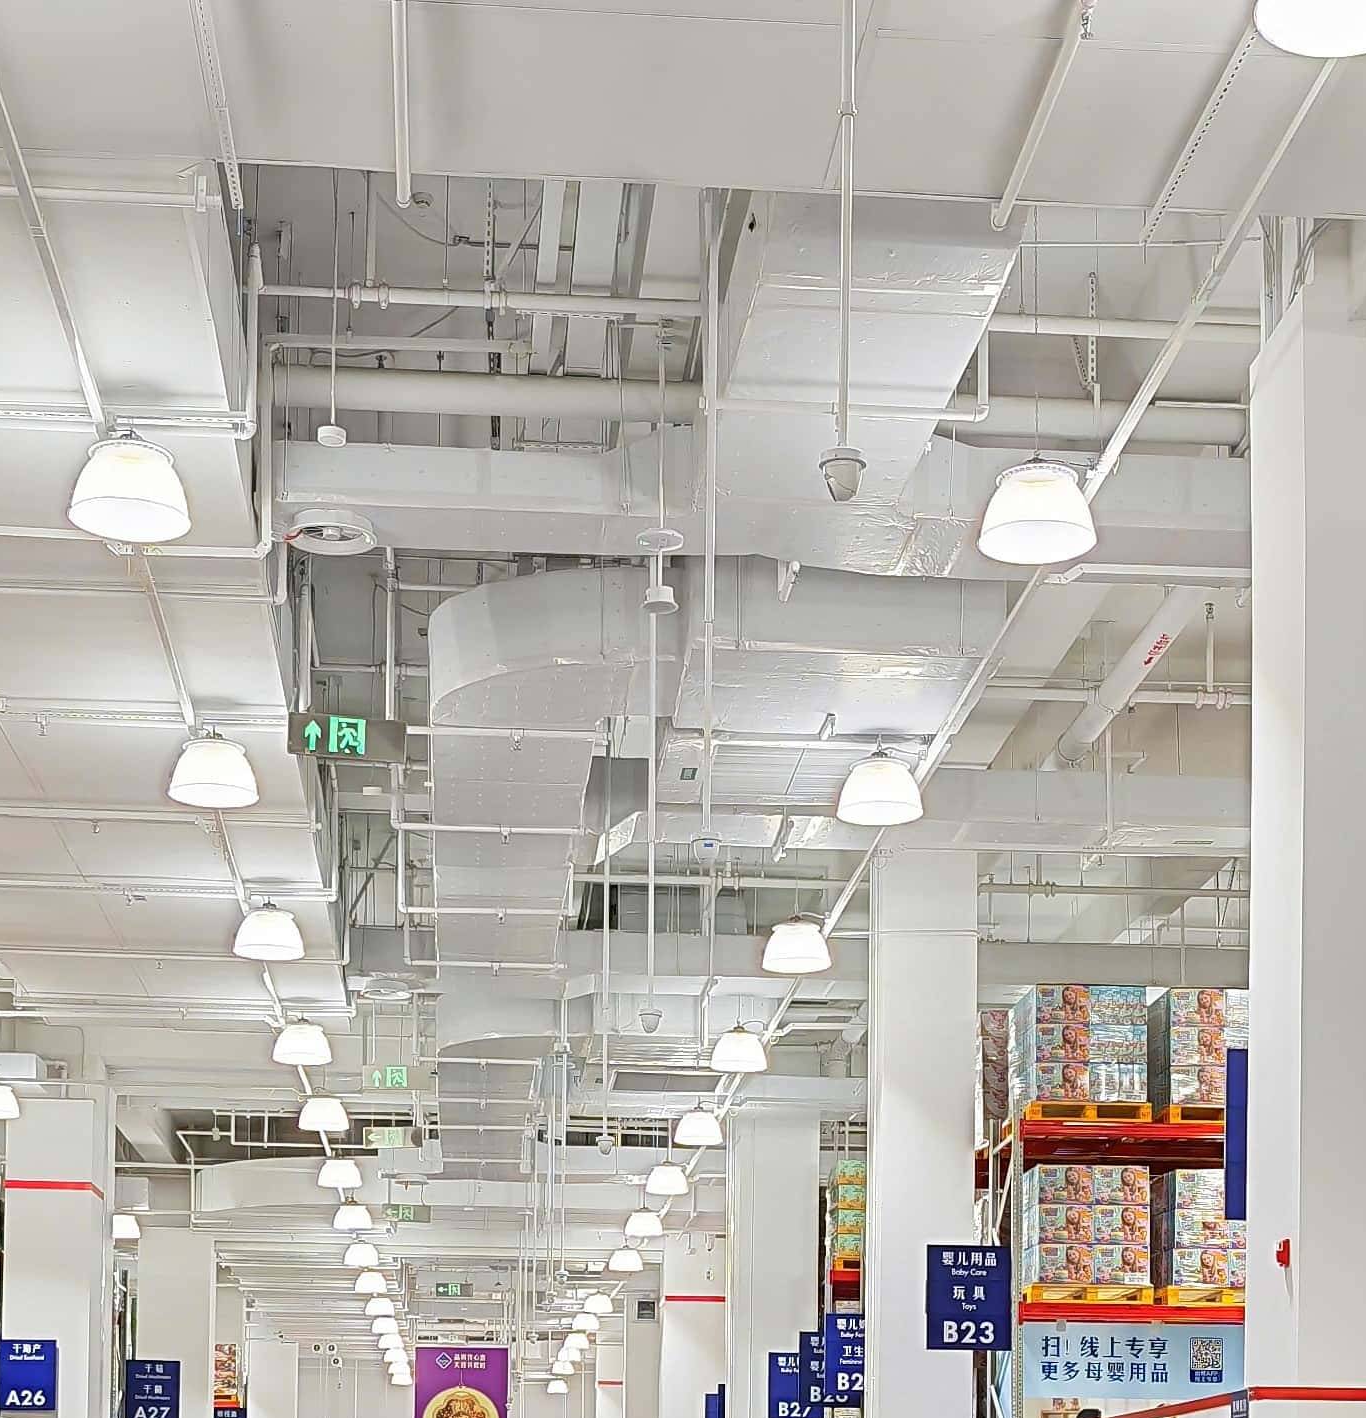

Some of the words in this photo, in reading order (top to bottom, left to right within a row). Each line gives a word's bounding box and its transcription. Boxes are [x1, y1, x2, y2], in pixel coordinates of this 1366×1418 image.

[942, 1251, 997, 1267] 婴儿用品
[951, 1268, 968, 1277] Baby
[969, 1268, 987, 1276] Care
[952, 1285, 986, 1300] 玩具
[961, 1302, 977, 1311] Toys
[942, 1320, 995, 1344] B23
[1040, 1361, 1168, 1383] 更多母婴用品
[837, 1372, 864, 1391] B2
[5, 1390, 46, 1406] A26
